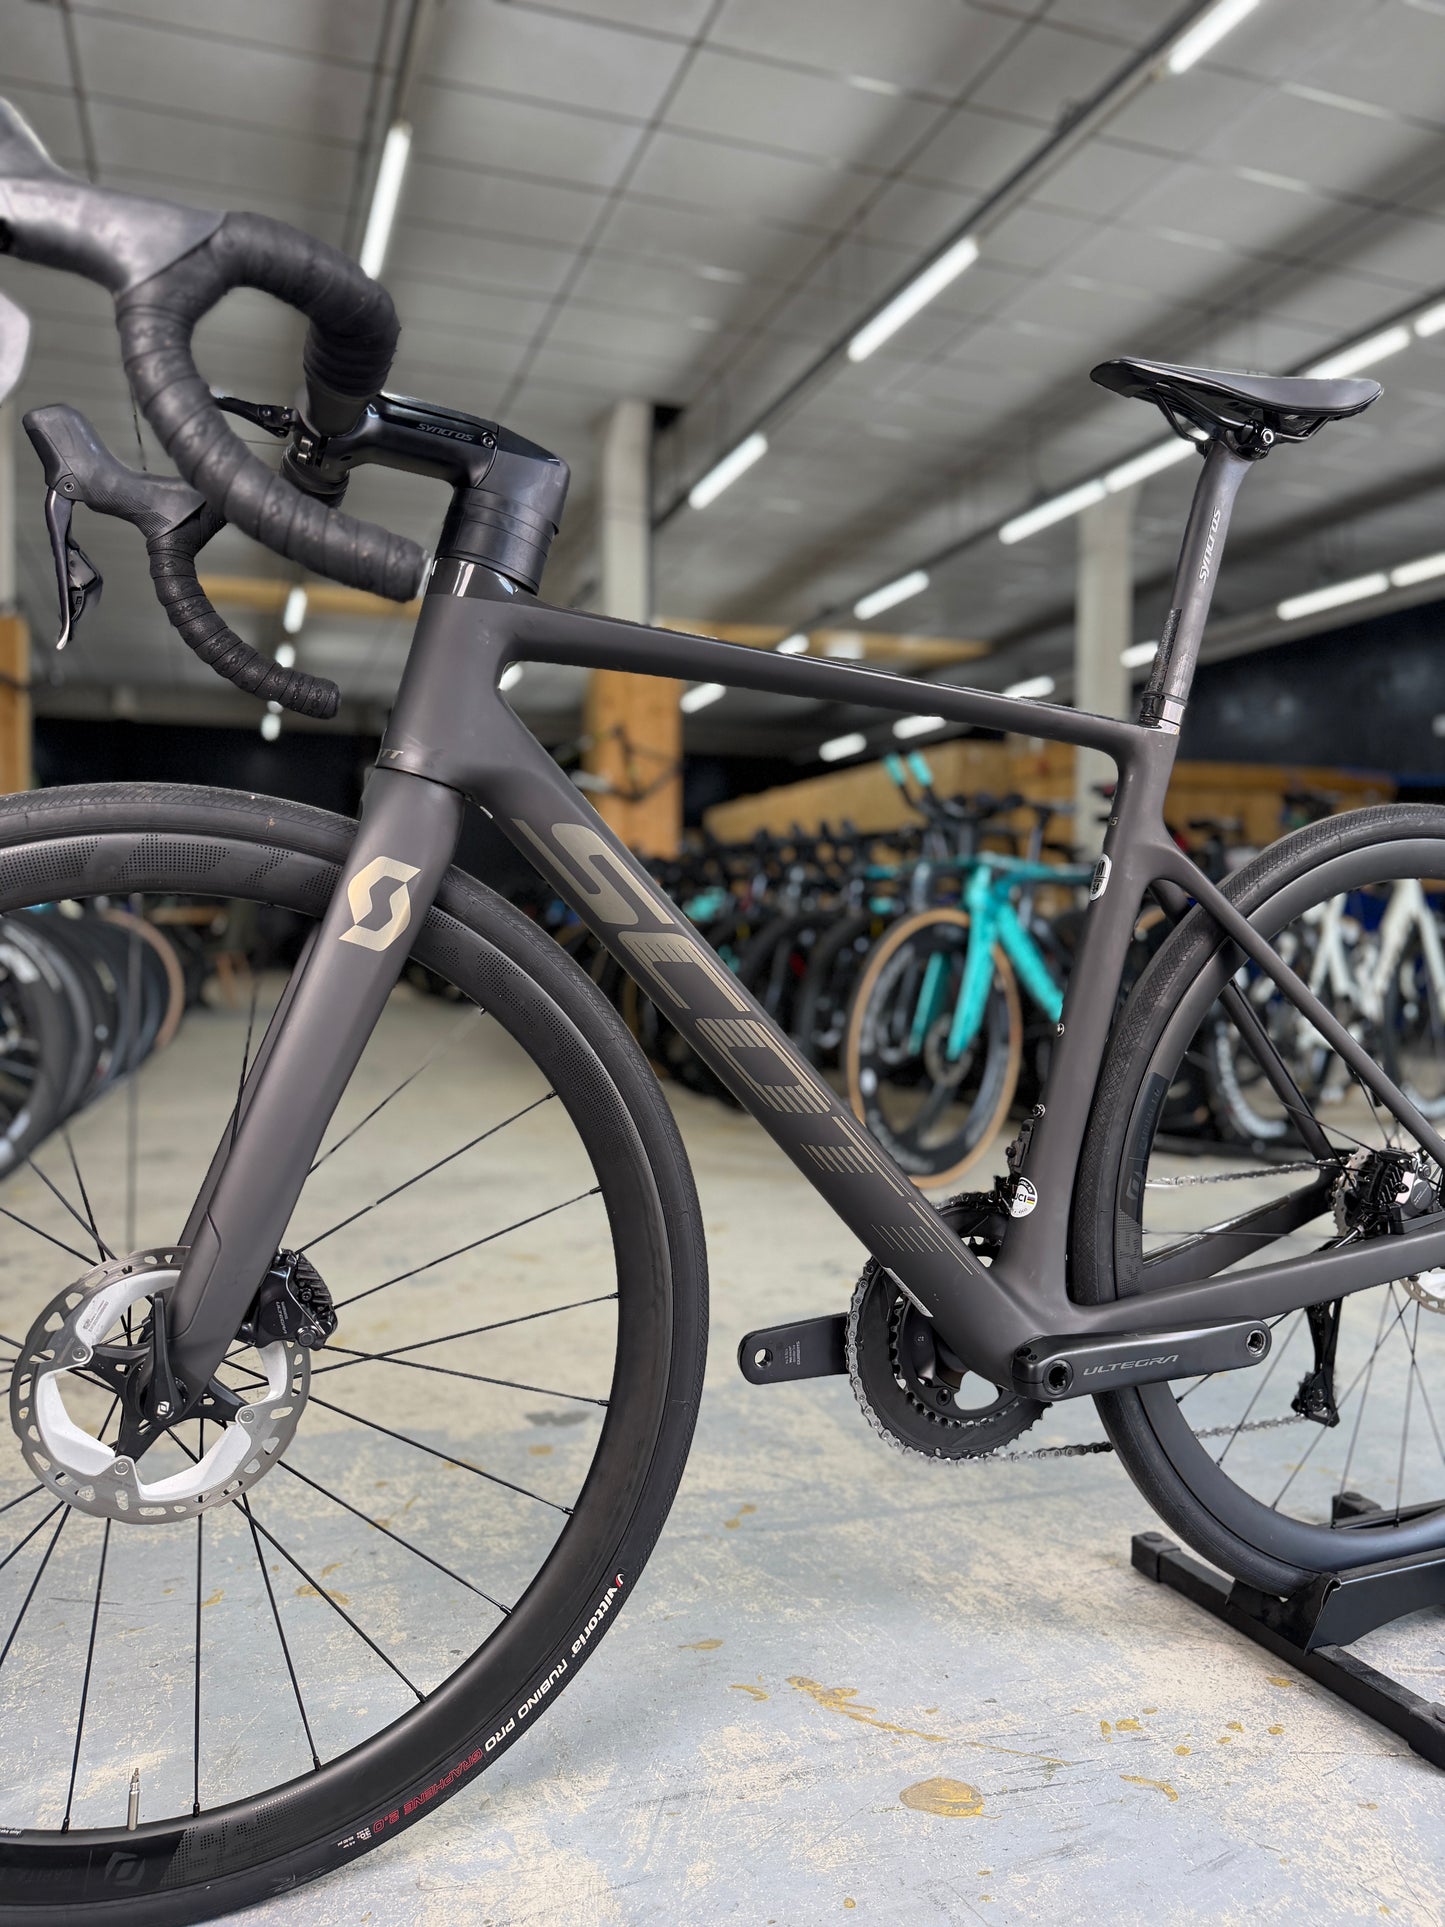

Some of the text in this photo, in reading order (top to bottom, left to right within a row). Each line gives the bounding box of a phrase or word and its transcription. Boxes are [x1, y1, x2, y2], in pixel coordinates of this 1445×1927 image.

[1083, 1354, 1179, 1376] ULTEGRA
[518, 1658, 568, 1720] RUBINO
[484, 1717, 516, 1751] PRO
[403, 1748, 483, 1815] GRAPHENE
[373, 1809, 400, 1833] 2.0
